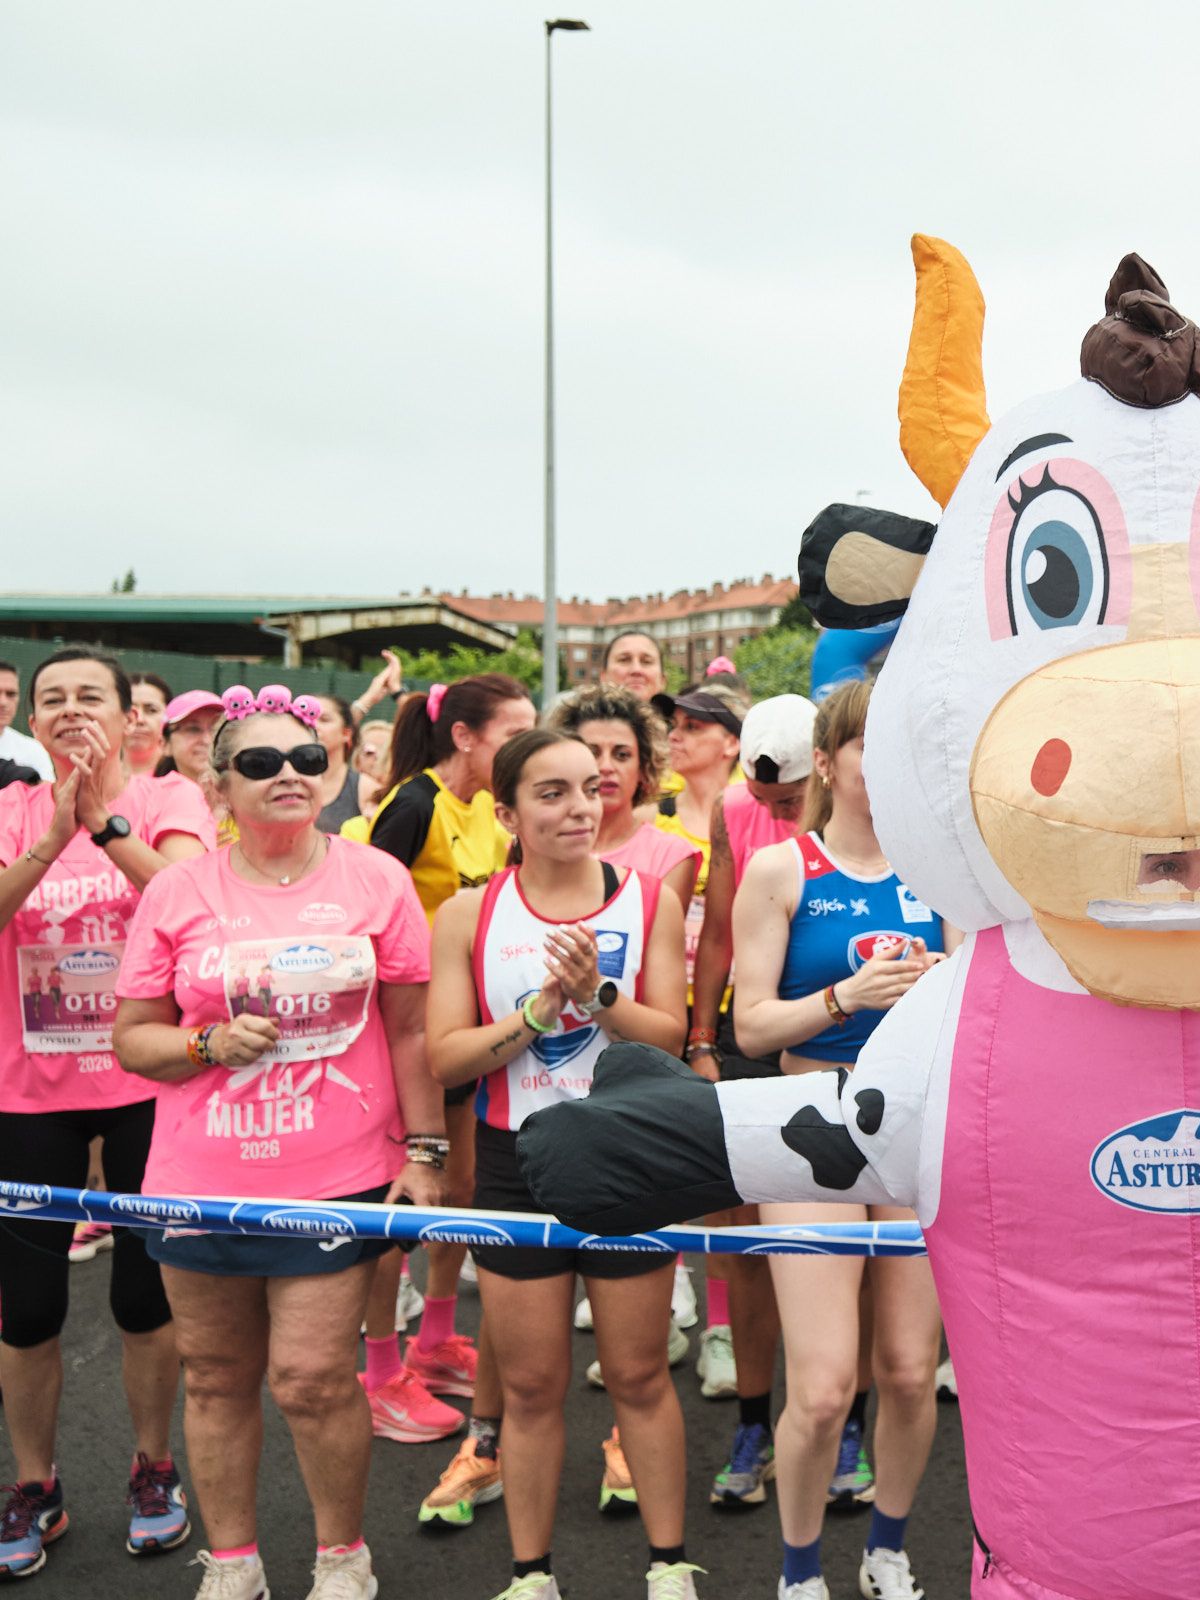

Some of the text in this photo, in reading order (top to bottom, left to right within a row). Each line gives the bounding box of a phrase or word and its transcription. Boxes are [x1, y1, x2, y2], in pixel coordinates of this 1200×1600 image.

[24, 869, 132, 912] ARRERA
[62, 958, 116, 971] ASTURIANA
[278, 956, 331, 967] ASTURIANA
[65, 993, 117, 1013] 016
[276, 993, 332, 1016] 016
[206, 1093, 315, 1138] MUJER
[240, 1140, 280, 1160] 2026
[1133, 1148, 1195, 1158] CENTRAL
[118, 1197, 194, 1220] ASTURIANA
[269, 1215, 350, 1235] ASTURIANA
